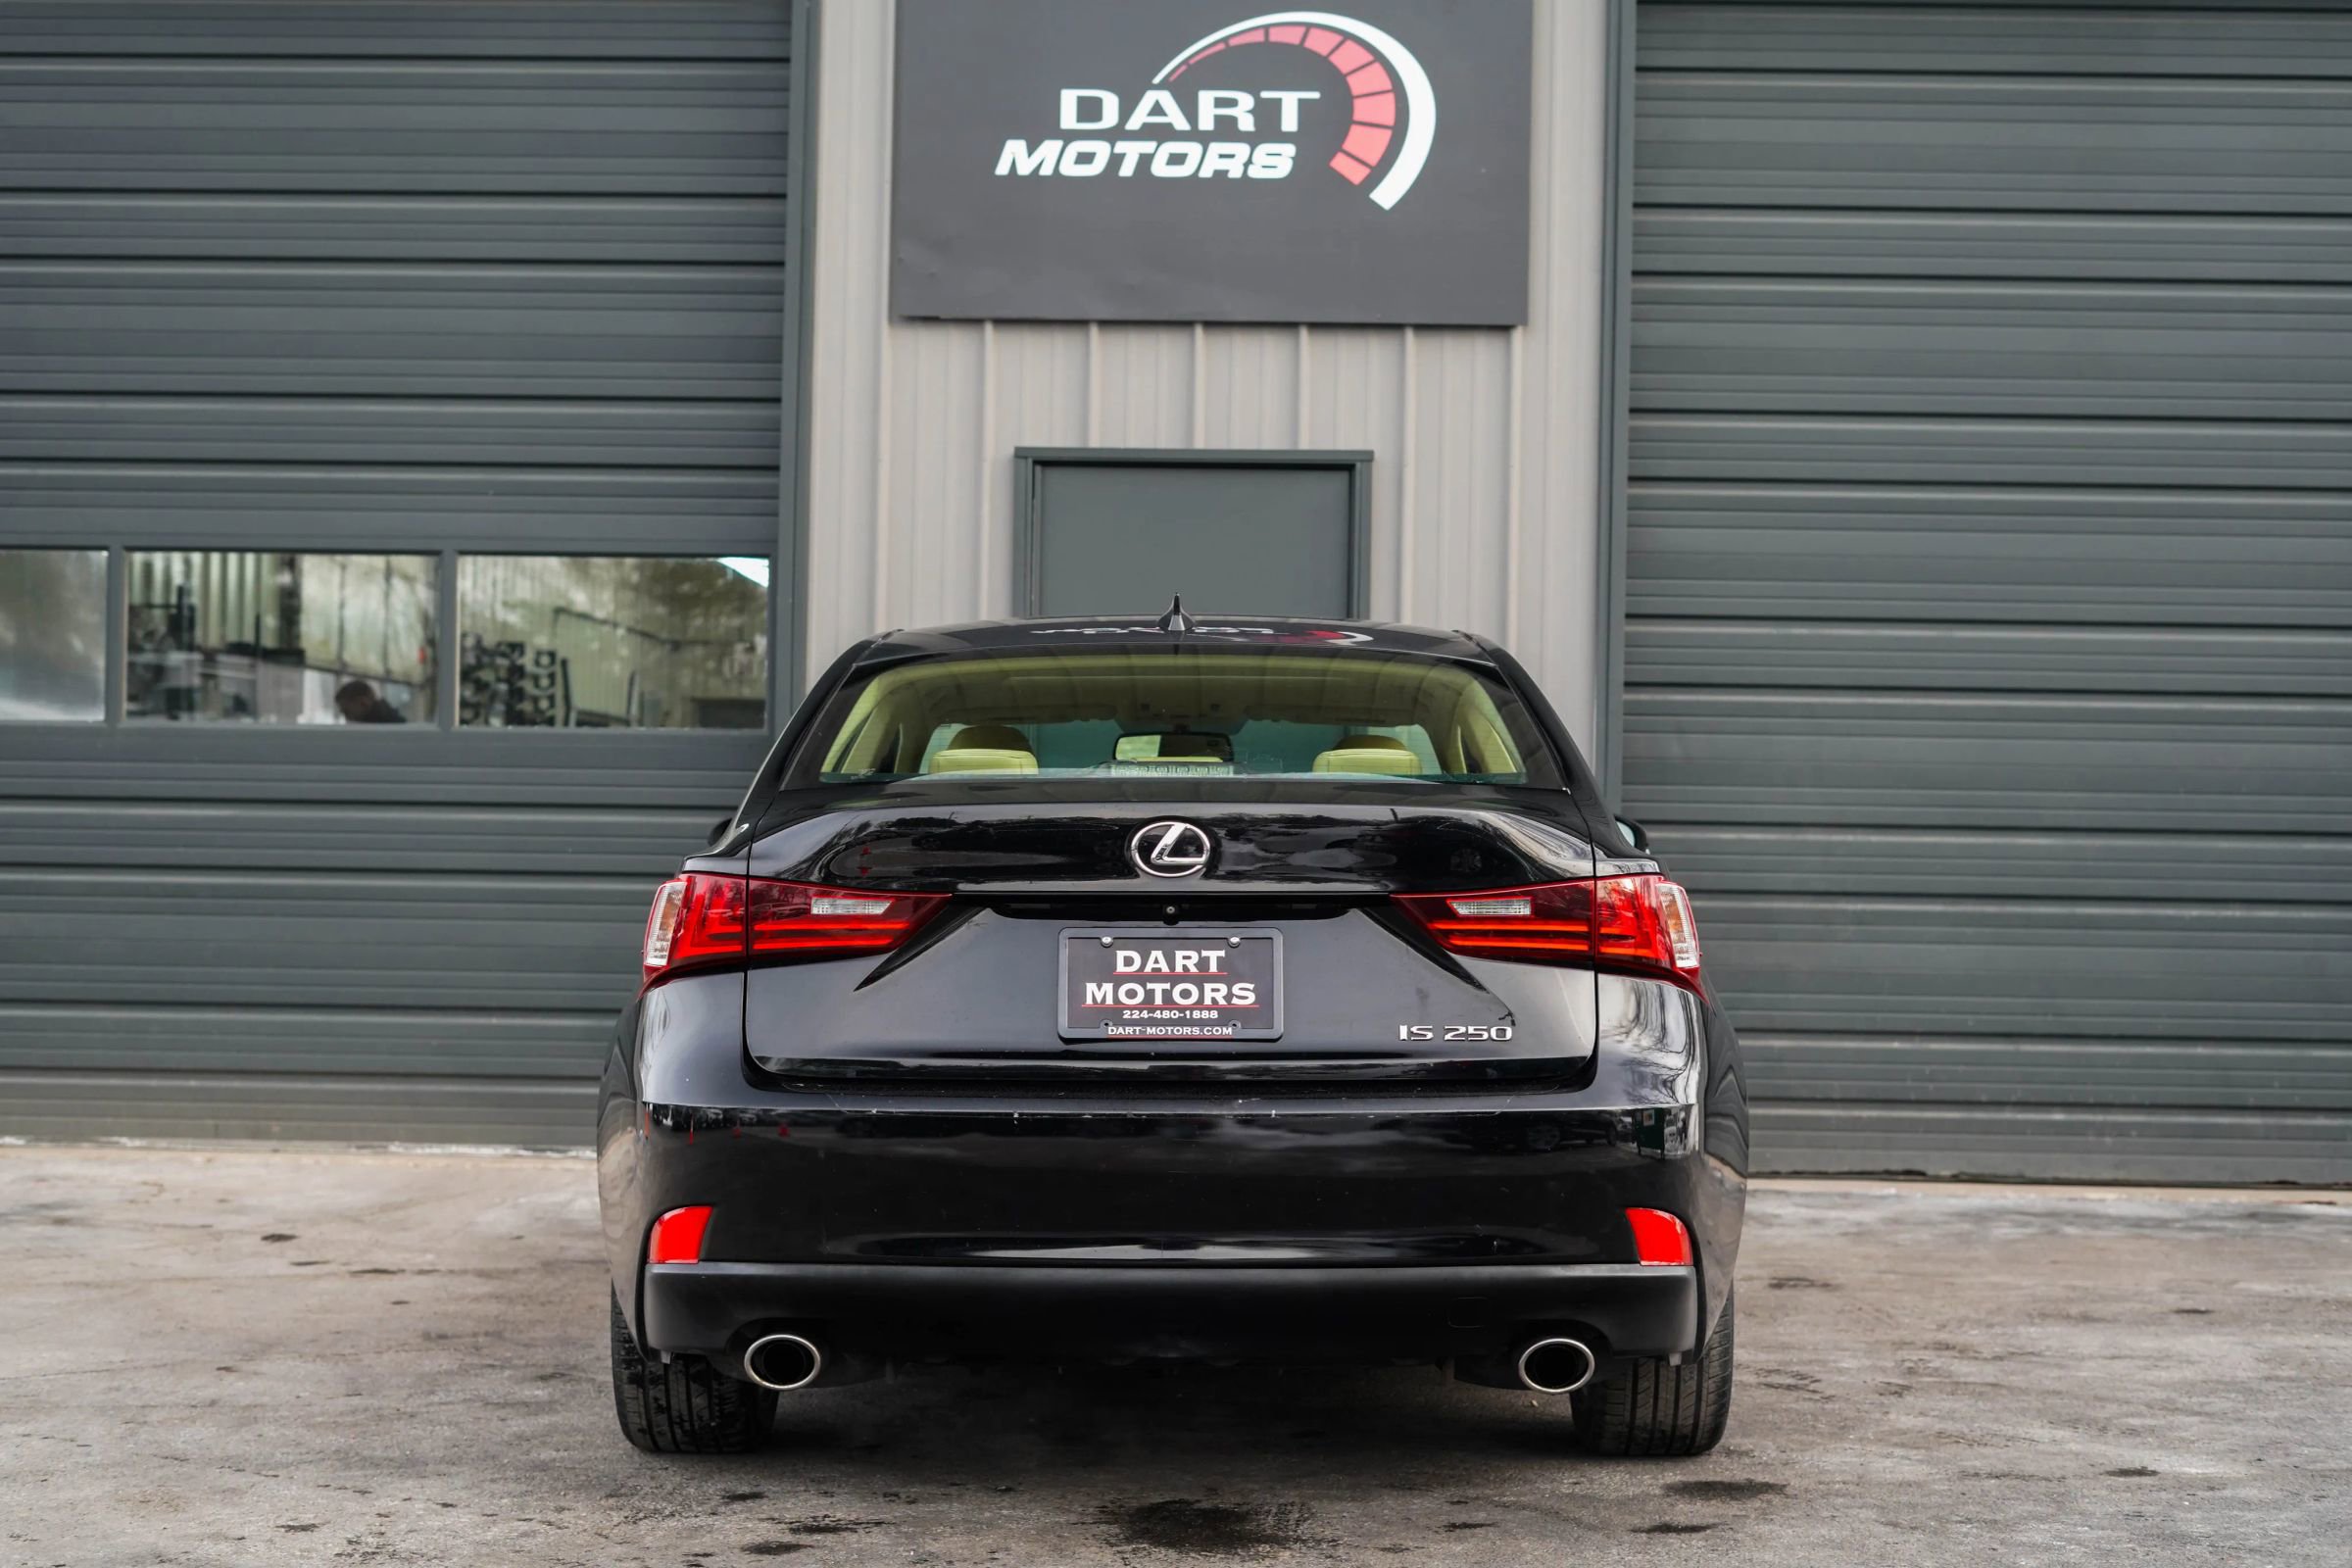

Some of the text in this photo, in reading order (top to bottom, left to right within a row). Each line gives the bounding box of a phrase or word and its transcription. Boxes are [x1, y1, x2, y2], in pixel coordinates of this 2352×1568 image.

[1059, 88, 1321, 131] DART
[995, 139, 1297, 179] MOTORS
[1115, 950, 1225, 973] DART
[1085, 982, 1256, 1005] MOTORS
[1122, 1009, 1219, 1019] 224-480-1888
[1107, 1026, 1233, 1036] DART-MOTORS.COM
[1398, 1024, 1513, 1041] IS 250
